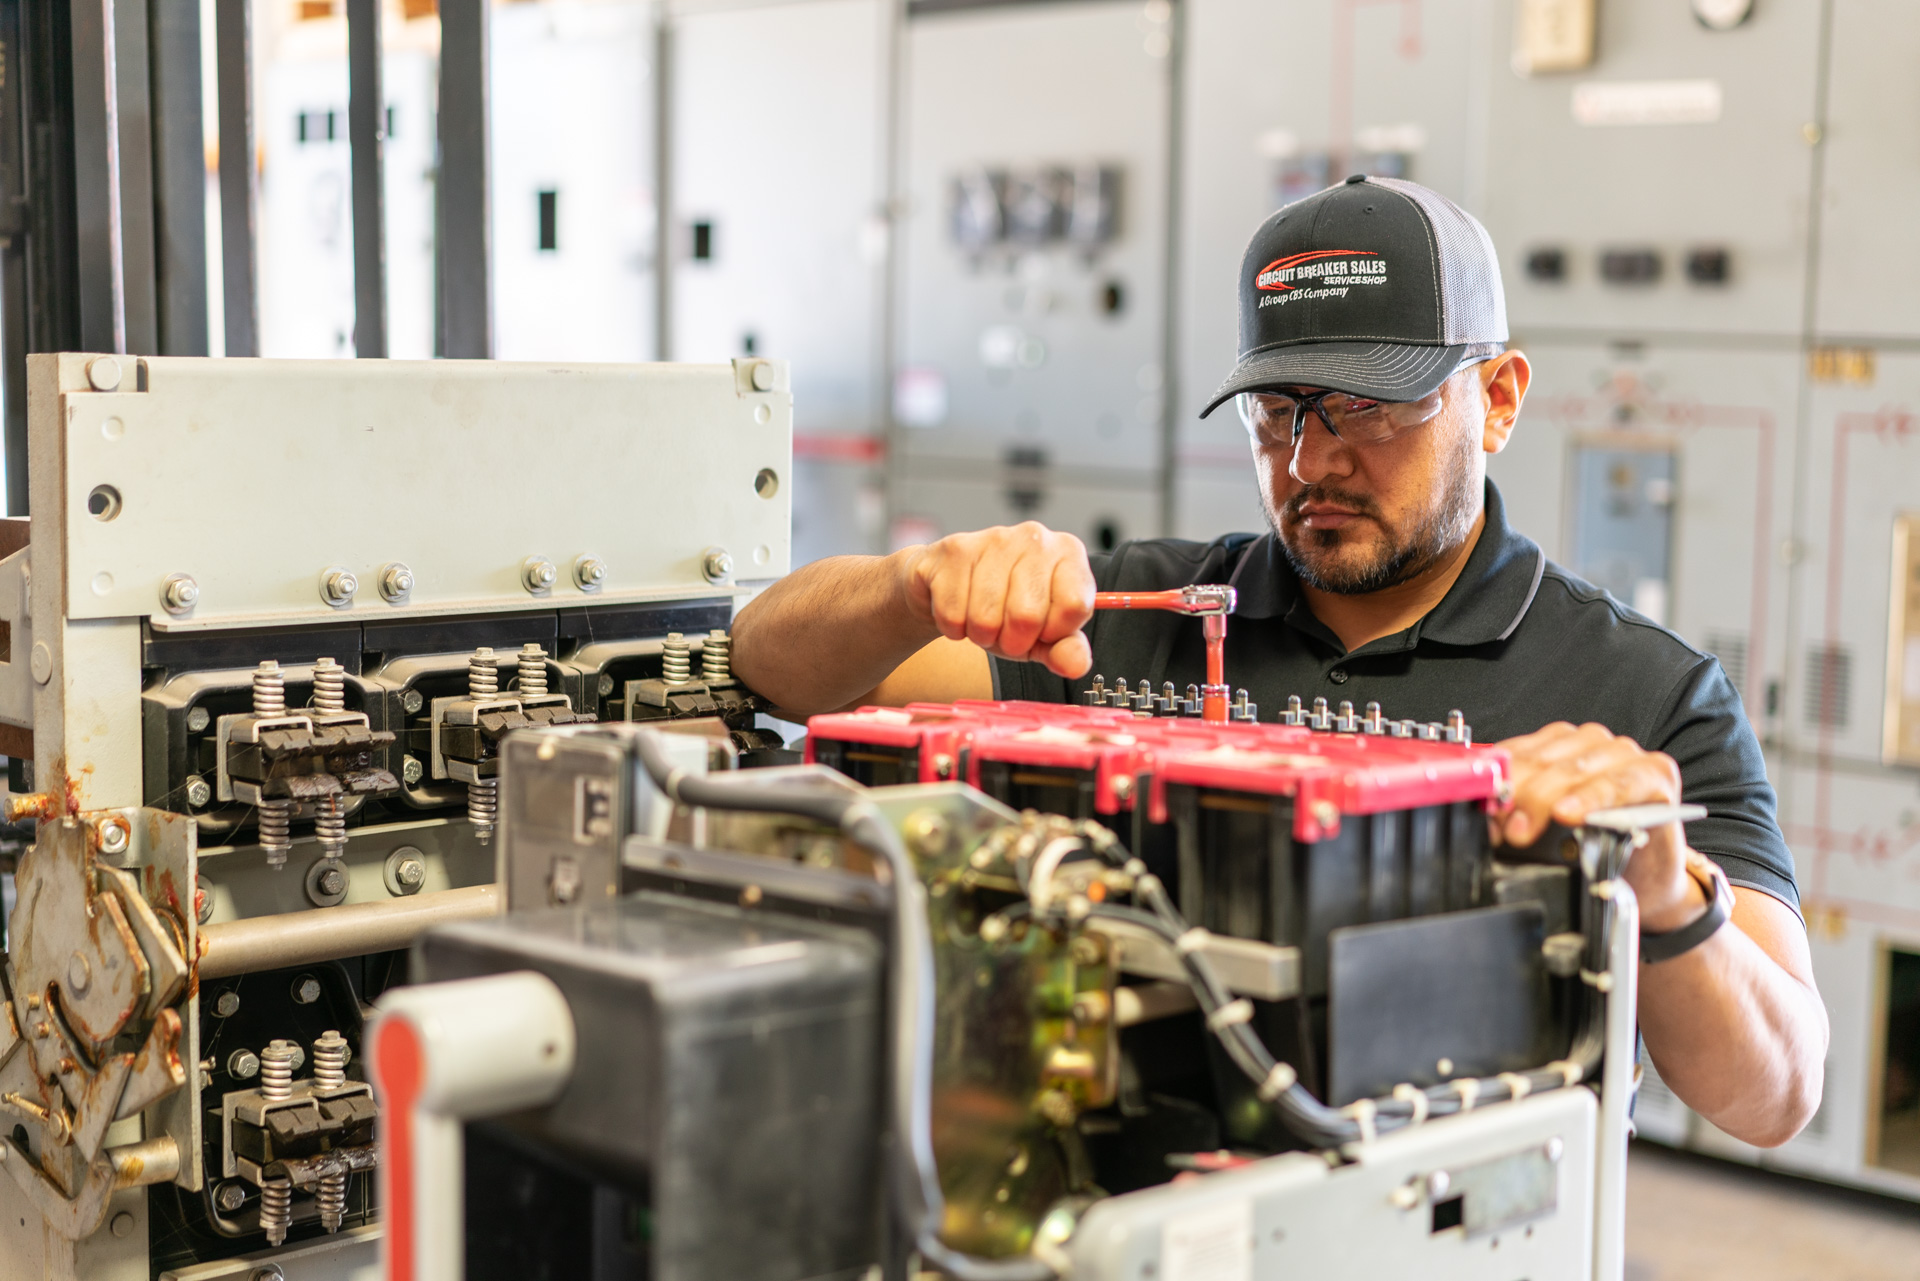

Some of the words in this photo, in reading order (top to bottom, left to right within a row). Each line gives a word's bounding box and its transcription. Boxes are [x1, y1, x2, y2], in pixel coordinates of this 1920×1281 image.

[1258, 268, 1296, 287] CIRCUIT
[1296, 261, 1348, 280] BREAKER
[1350, 259, 1386, 275] SALES
[1258, 296, 1265, 309] A
[1264, 294, 1289, 306] Group
[1289, 288, 1304, 302] CBS
[1303, 287, 1350, 300] Company
